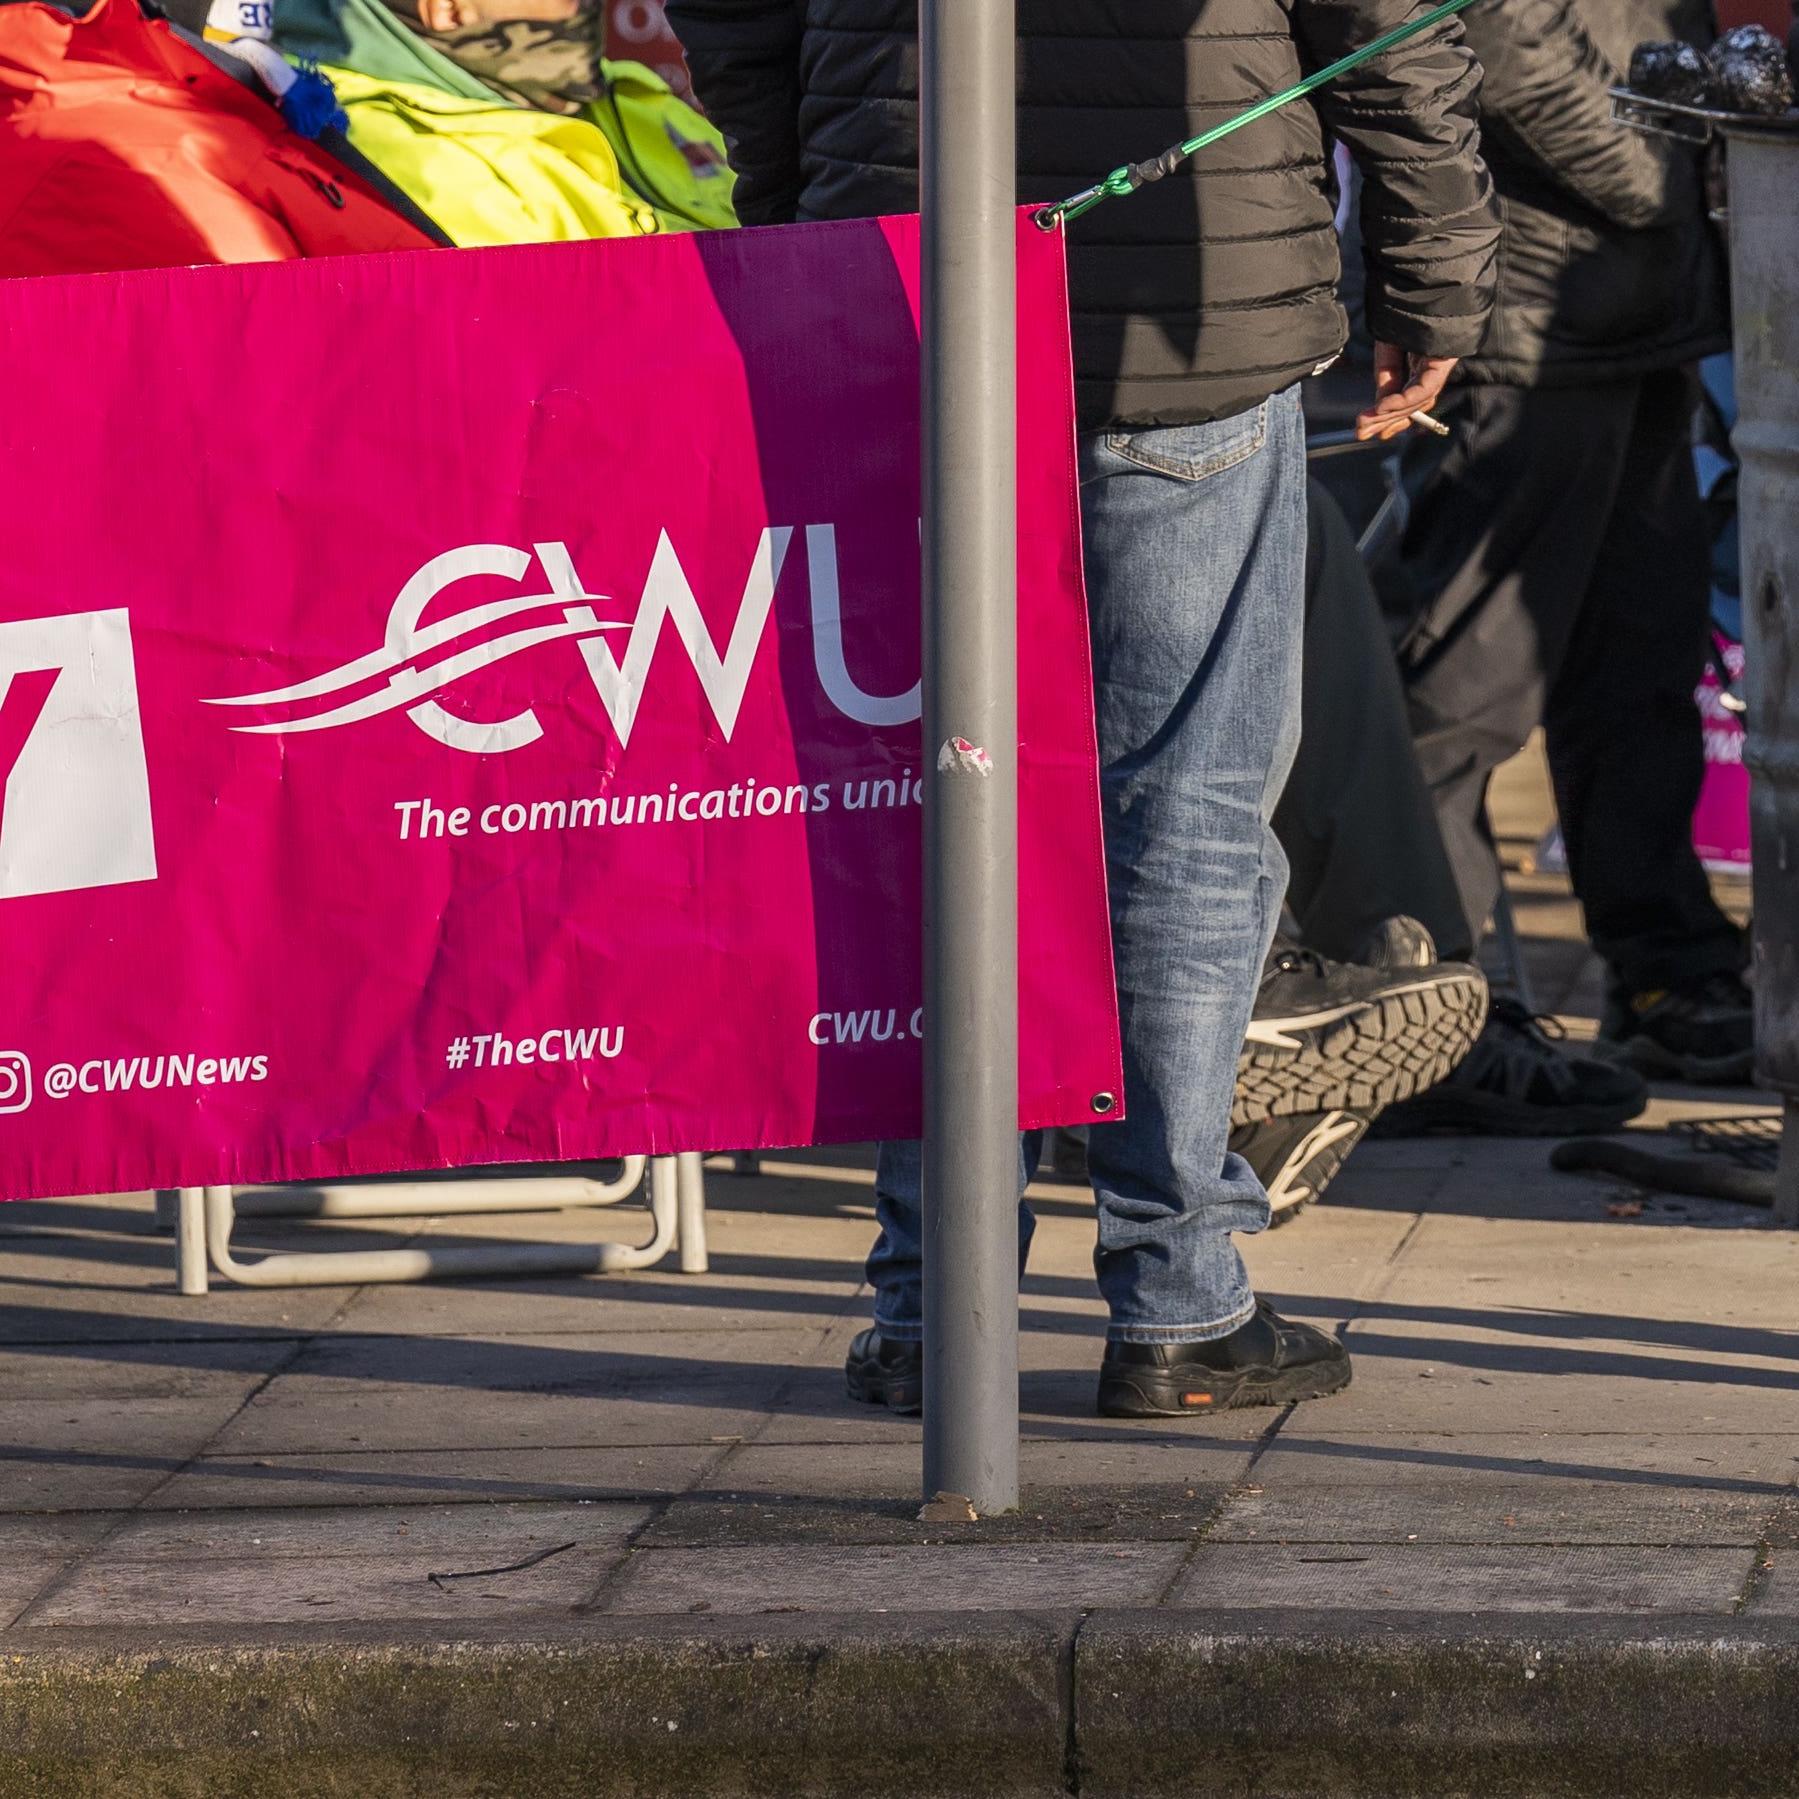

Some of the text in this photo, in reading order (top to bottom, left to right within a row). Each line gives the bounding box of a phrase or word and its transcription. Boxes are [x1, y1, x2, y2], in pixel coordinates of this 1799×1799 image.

[385, 523, 922, 754] CWU
[393, 798, 471, 840] The
[480, 777, 830, 834] communications
[445, 1026, 625, 1069] #TheCWU
[44, 1053, 268, 1099] @CWUNews
